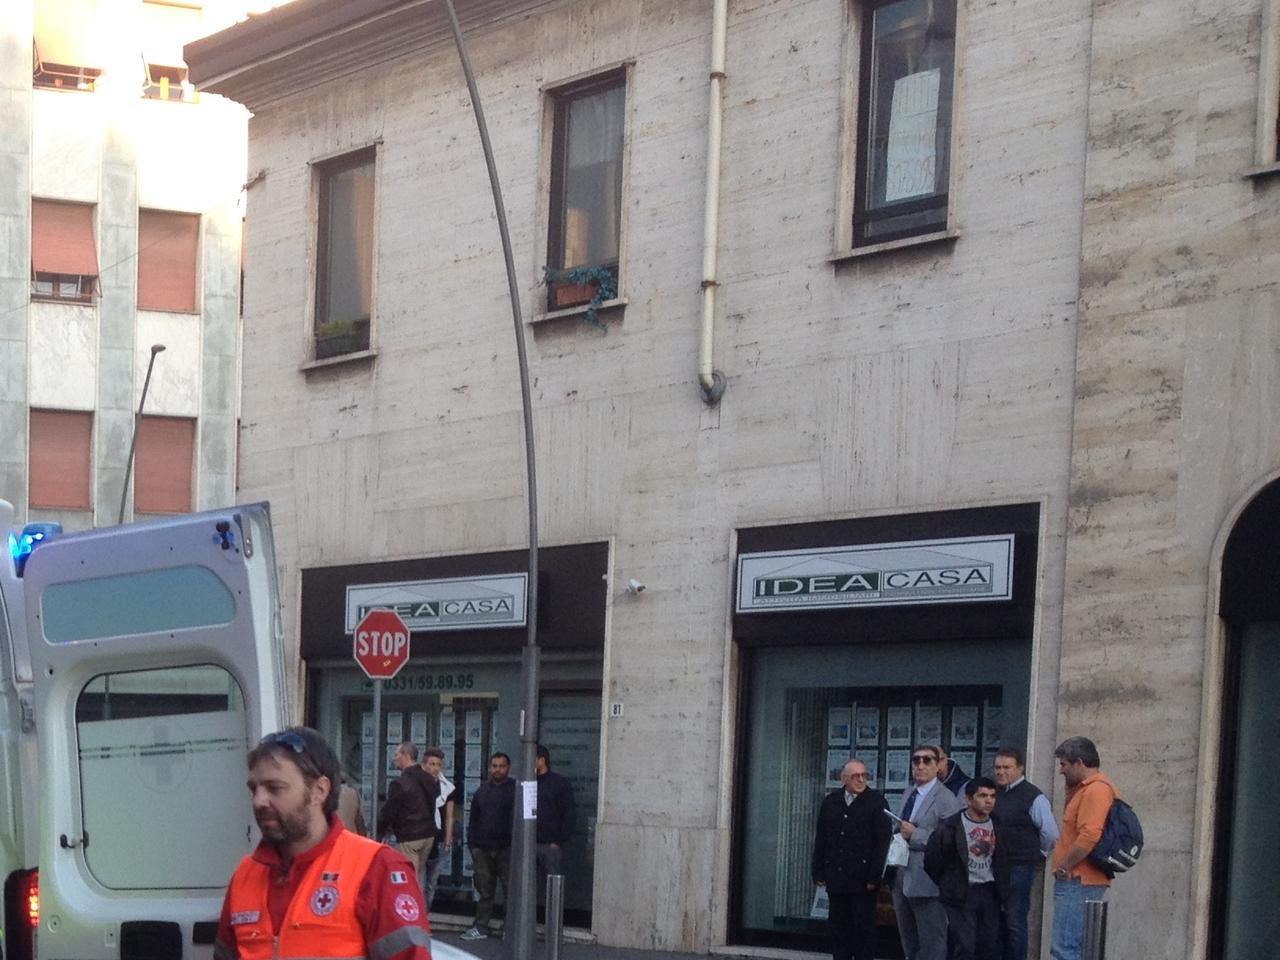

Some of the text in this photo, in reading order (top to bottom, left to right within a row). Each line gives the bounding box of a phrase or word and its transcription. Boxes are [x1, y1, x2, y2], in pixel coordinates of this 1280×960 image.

[757, 573, 874, 597] IDEA
[886, 568, 988, 588] CASA
[360, 599, 510, 619] IEA CASA
[357, 631, 406, 657] STOP
[612, 703, 622, 715] 81
